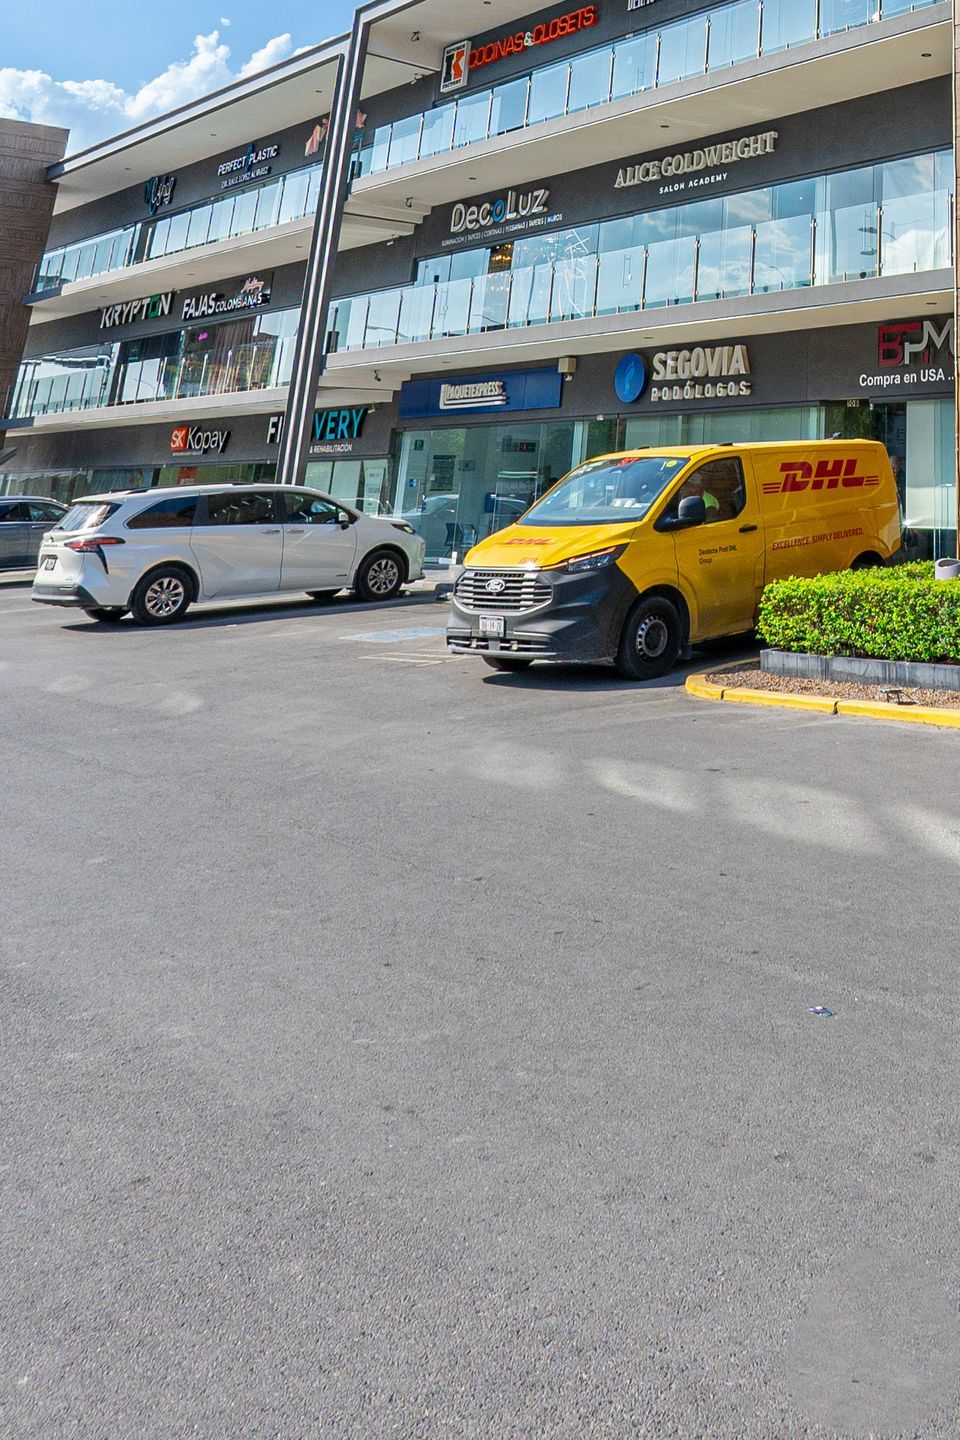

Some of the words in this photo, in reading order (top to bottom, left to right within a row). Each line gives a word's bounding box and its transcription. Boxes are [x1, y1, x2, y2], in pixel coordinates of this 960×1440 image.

[217, 156, 247, 176] PERFECT
[248, 145, 279, 165] PLASTIC
[614, 160, 661, 188] ALICE
[661, 131, 779, 177] GOLDWEIGHT
[659, 182, 685, 195] SALON
[688, 172, 729, 188] ACADEMY
[100, 292, 173, 329] KRYPTON
[181, 293, 217, 320] FAJAS
[215, 292, 263, 313] COLOMBIANAS
[652, 344, 750, 381] SEGOVIA
[651, 380, 751, 402] PODÓLOGOS
[859, 374, 901, 388] Compra
[903, 373, 917, 383] en
[920, 368, 945, 382] USA
[170, 430, 187, 448] SK
[186, 426, 228, 453] Kopay
[779, 459, 865, 493] DHL
[719, 545, 728, 553] Post
[811, 532, 833, 545] SIMPLY
